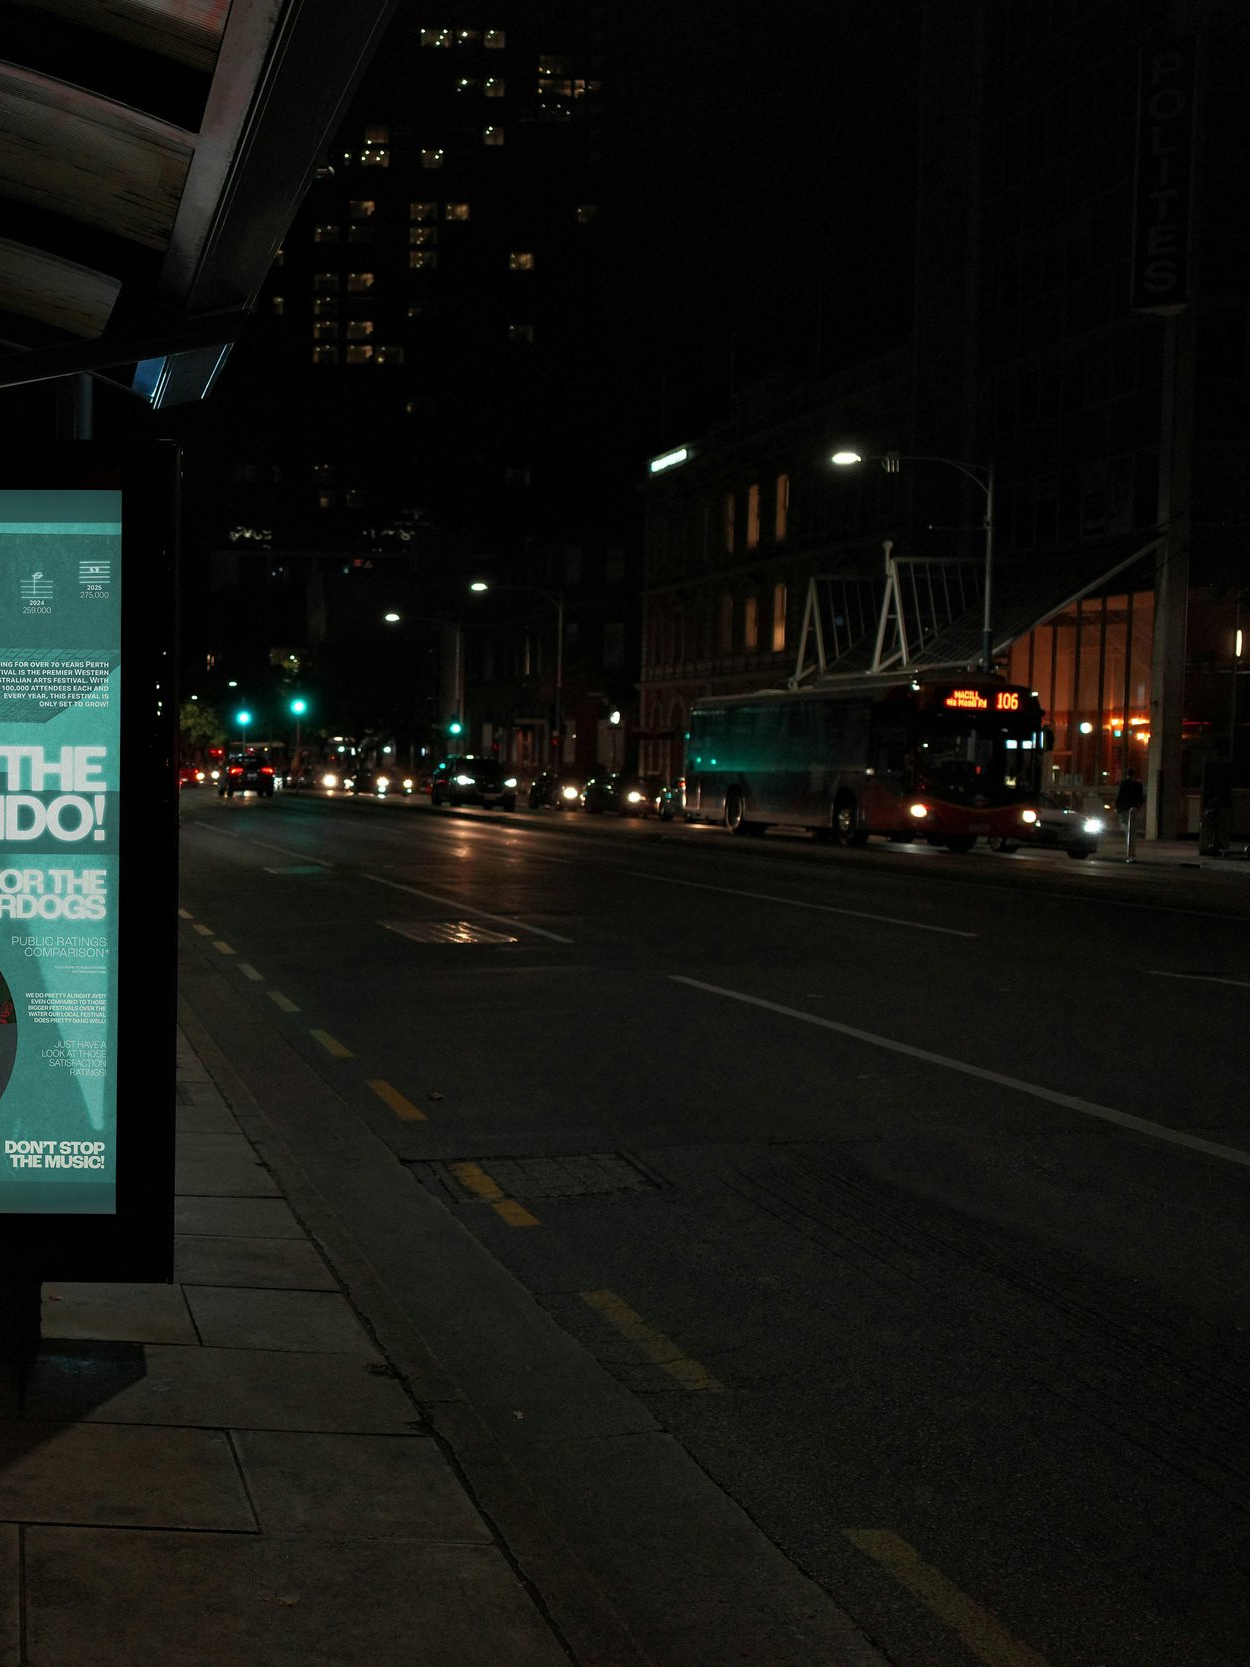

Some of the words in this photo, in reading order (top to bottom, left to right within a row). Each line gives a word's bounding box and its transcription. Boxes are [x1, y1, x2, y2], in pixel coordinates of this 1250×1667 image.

[1144, 53, 1186, 293] POLITES
[997, 692, 1019, 710] 106
[49, 869, 106, 894] THE
[12, 936, 54, 946] PUBLIC
[56, 936, 106, 946] RATINGS
[42, 1050, 66, 1058] LOOK
[66, 1050, 78, 1058] AT
[78, 1050, 106, 1058] THOSE
[49, 1059, 106, 1067] SATISFACTION
[70, 1068, 106, 1076] RATINGS!
[4, 1140, 57, 1154] DON'T
[60, 1140, 105, 1154] STOP
[10, 1154, 42, 1168] THE
[44, 1154, 105, 1168] MUSIC!
